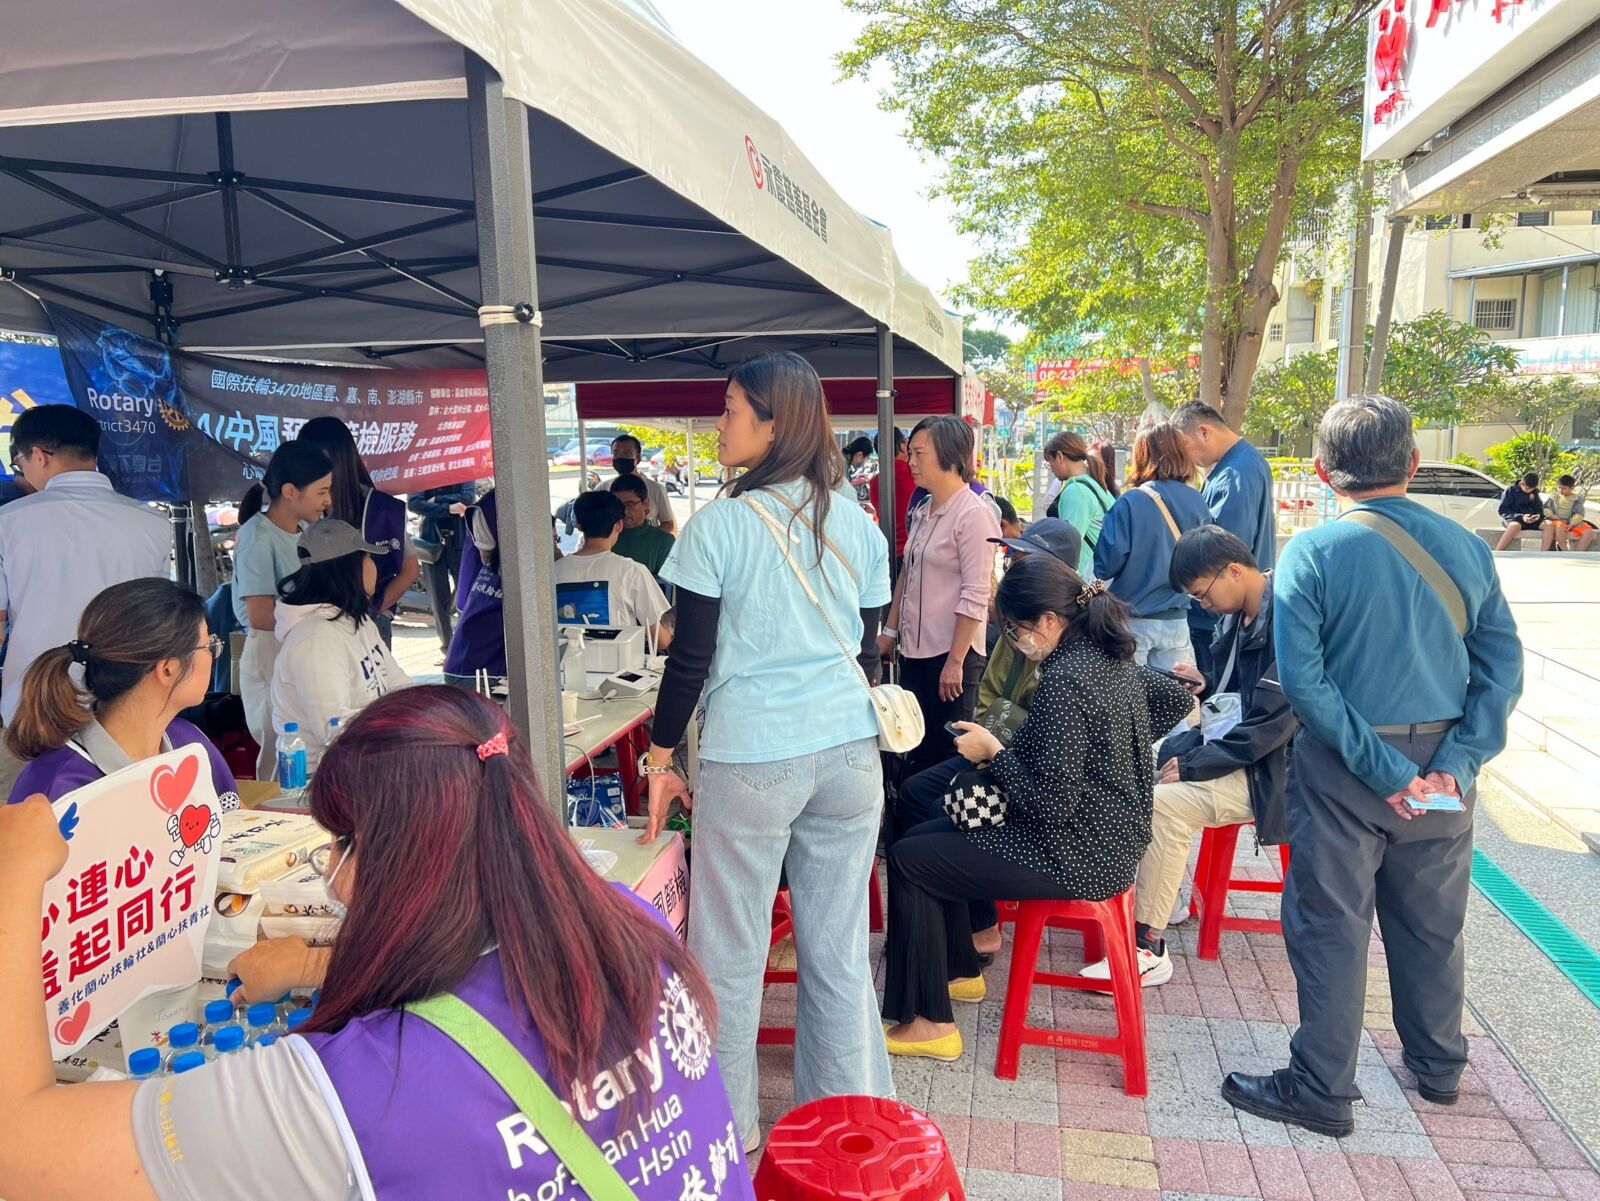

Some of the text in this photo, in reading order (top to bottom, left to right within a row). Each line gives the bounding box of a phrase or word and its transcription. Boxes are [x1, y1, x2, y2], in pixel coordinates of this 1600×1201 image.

[87, 387, 154, 417] Rotary
[98, 419, 156, 434] trict3470
[58, 904, 210, 1015] 善化蘭心扶輪社&蘭心扶青社
[496, 1037, 663, 1169] Rtary
[637, 1094, 683, 1143] Hua
